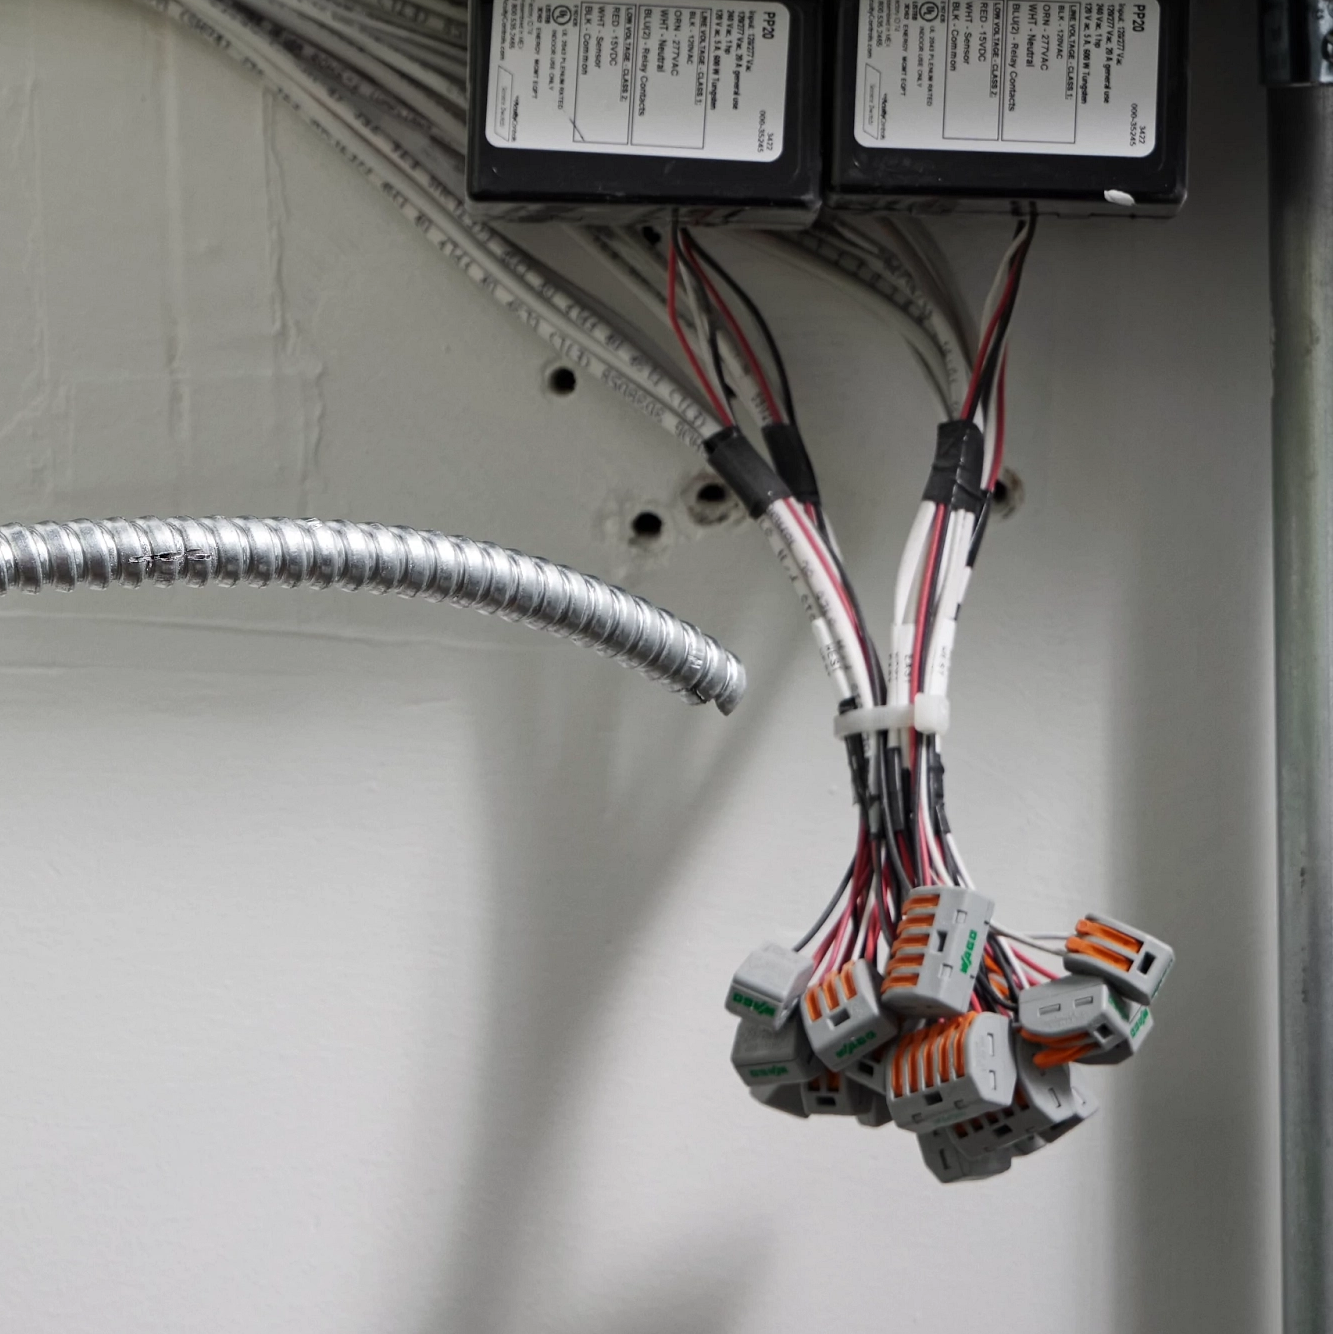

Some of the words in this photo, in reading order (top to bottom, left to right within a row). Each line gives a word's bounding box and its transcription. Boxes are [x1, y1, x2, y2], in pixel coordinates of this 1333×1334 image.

[583, 5, 592, 25] BLK
[596, 5, 605, 28] WHT
[610, 6, 620, 27] RED
[641, 7, 651, 40] BLU(2)
[659, 8, 668, 31] WHT
[673, 9, 682, 32] ORN
[688, 10, 696, 27] BLK
[951, 0, 960, 21] BLK
[964, 1, 972, 23] WHT
[979, 1, 987, 22] RED
[1009, 2, 1019, 34] BLU(2)
[1027, 3, 1037, 25] WHT
[1041, 3, 1050, 26] ORN
[1068, 4, 1076, 21] LINE
[1131, 3, 1145, 32] PP20
[761, 11, 775, 40] PP20
[991, 21, 1000, 57] VOLTAGE
[580, 32, 591, 75] Common
[594, 35, 603, 69] Sensor
[608, 35, 618, 66] 15VDC
[622, 26, 631, 62] VOLTAGE
[656, 38, 667, 73] Neutral
[697, 29, 706, 65] VOLTAGE
[949, 28, 959, 71] Common
[962, 31, 971, 65] Sensor
[977, 31, 986, 62] 15VDC
[1007, 42, 1018, 68] Relay
[1025, 33, 1036, 67] Neutral
[1040, 34, 1049, 71] 277VAC
[1056, 28, 1064, 59] 120VAC
[1067, 23, 1075, 59] VOLTAGE
[638, 47, 649, 73] Relay
[670, 39, 680, 76] 277VAC
[1115, 52, 1123, 66] Vac
[621, 68, 629, 93] CLASS
[696, 71, 704, 96] CLASS
[731, 69, 741, 96] general
[990, 63, 998, 88] CLASS
[1007, 69, 1017, 111] Contacts
[1066, 65, 1074, 91] CLASS
[1102, 63, 1112, 89] general
[637, 74, 648, 116] Contacts
[1129, 103, 1137, 147] 000-35245
[1138, 125, 1146, 144] 3422
[960, 929, 978, 974] WAGO
